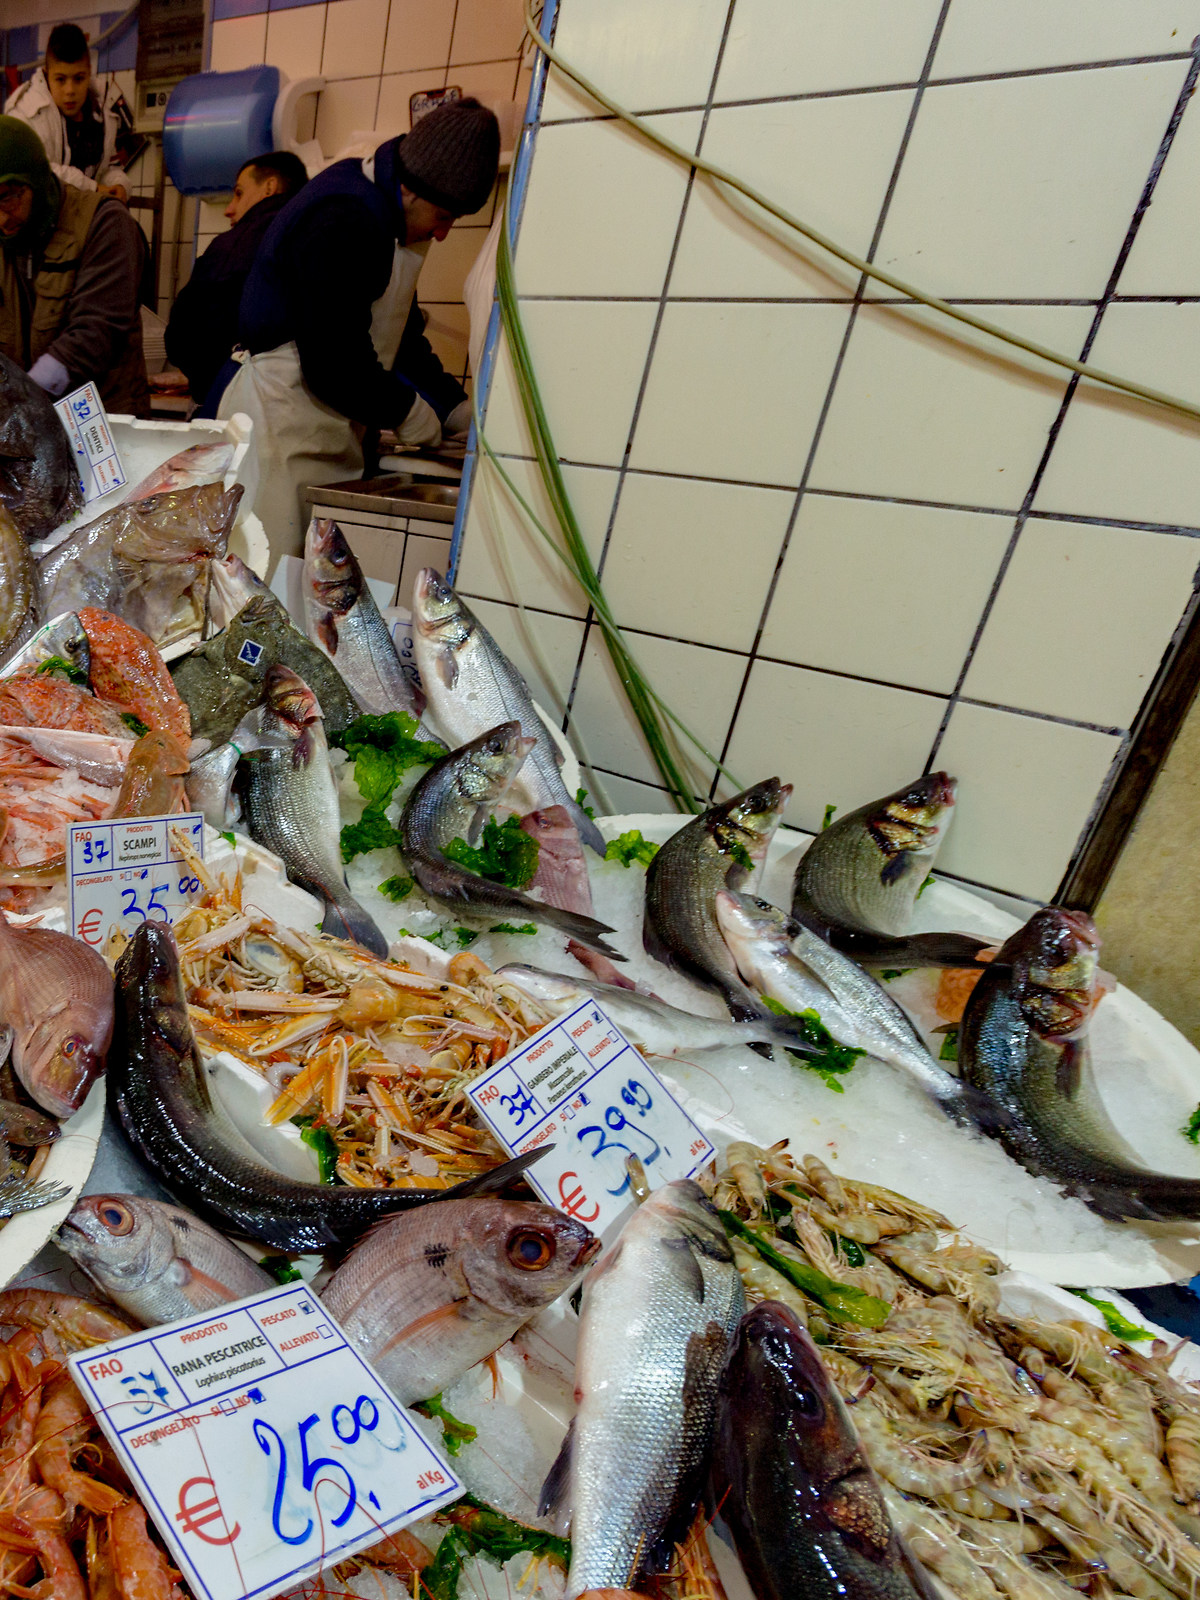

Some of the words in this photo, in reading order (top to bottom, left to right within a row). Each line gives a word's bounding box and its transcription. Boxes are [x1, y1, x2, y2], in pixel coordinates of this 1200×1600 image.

[90, 426, 104, 454] DENTICI
[75, 832, 92, 842] FAO
[126, 825, 153, 833] PRODOTTO
[83, 840, 109, 864] 37
[123, 837, 157, 851] SCAMPI
[76, 876, 113, 887] DECONGELATO
[77, 909, 103, 945] €
[571, 1020, 593, 1039] PESCATO
[526, 1039, 554, 1063] PRODOTTO
[587, 1037, 611, 1059] ALLEVATO
[527, 1066, 554, 1090] GAMBERO
[551, 1046, 579, 1071] IMPERIALE
[478, 1084, 500, 1107] FAO
[500, 1084, 537, 1126] 37
[558, 1171, 600, 1222] €
[260, 1308, 297, 1327] PESCATO
[180, 1322, 228, 1344] PRODOTTO
[279, 1331, 320, 1352] ALLEVATO
[172, 1357, 206, 1377] RANA
[204, 1335, 267, 1365] PESCATRICE
[88, 1358, 123, 1381] FAO
[195, 1368, 226, 1388] Lophius
[226, 1357, 266, 1380] piscatorius
[120, 1367, 169, 1415] 37
[234, 1394, 251, 1407] NO
[210, 1405, 222, 1417] SI
[130, 1415, 200, 1449] DECONGELATO
[416, 1474, 428, 1490] al
[425, 1469, 446, 1487] Kg
[175, 1476, 241, 1546] €
